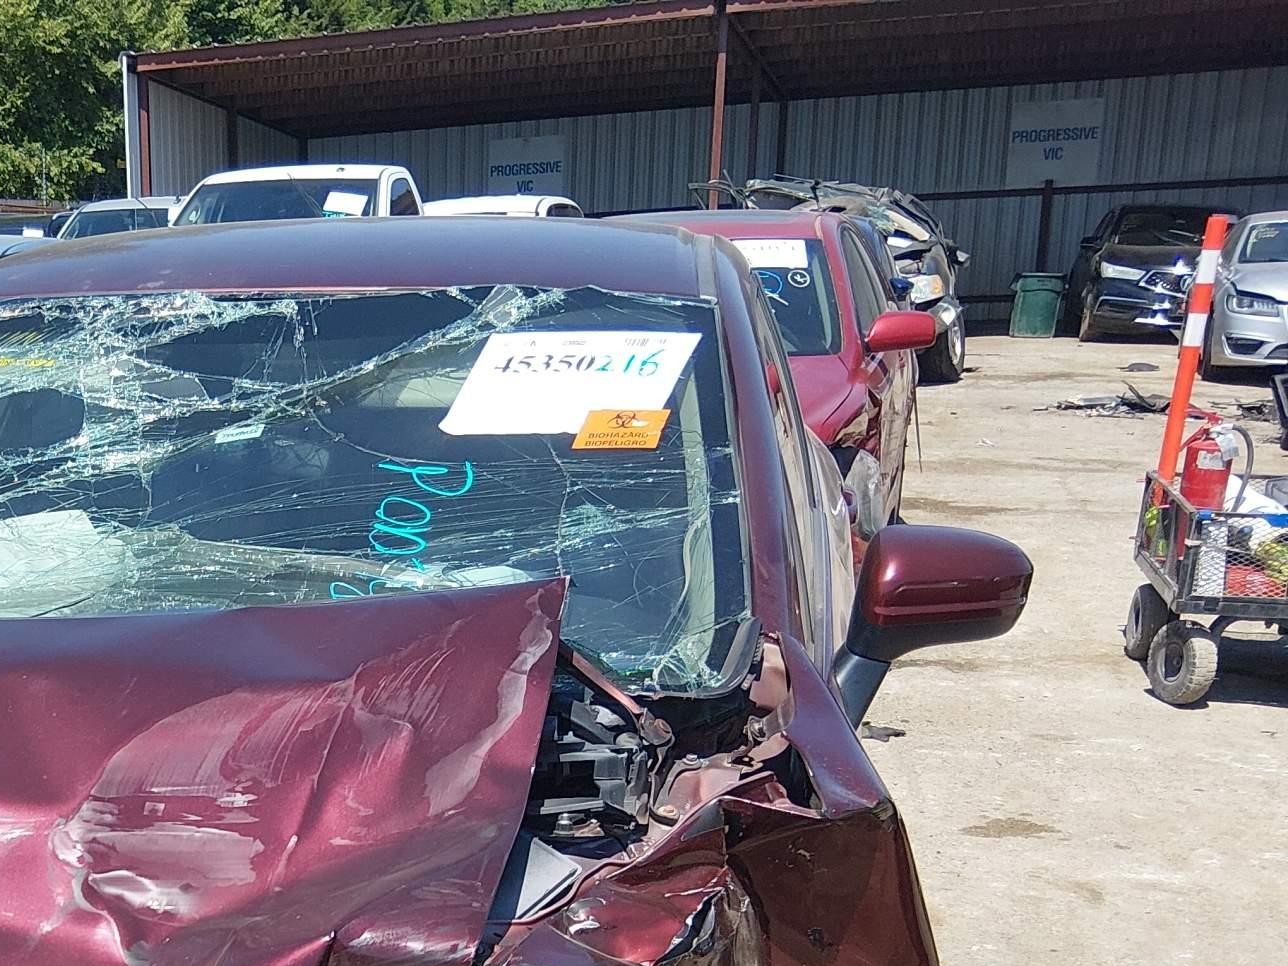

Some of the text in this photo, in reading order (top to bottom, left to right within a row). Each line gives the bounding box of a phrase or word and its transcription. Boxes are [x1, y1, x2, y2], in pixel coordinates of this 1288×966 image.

[1012, 126, 1100, 143] PROGRESSIVE
[1043, 147, 1064, 160] VIC
[490, 161, 562, 177] PROGRESSIVE
[516, 180, 534, 193] VIC
[494, 349, 665, 377] 45350216
[588, 431, 649, 439] BIOHAZARD
